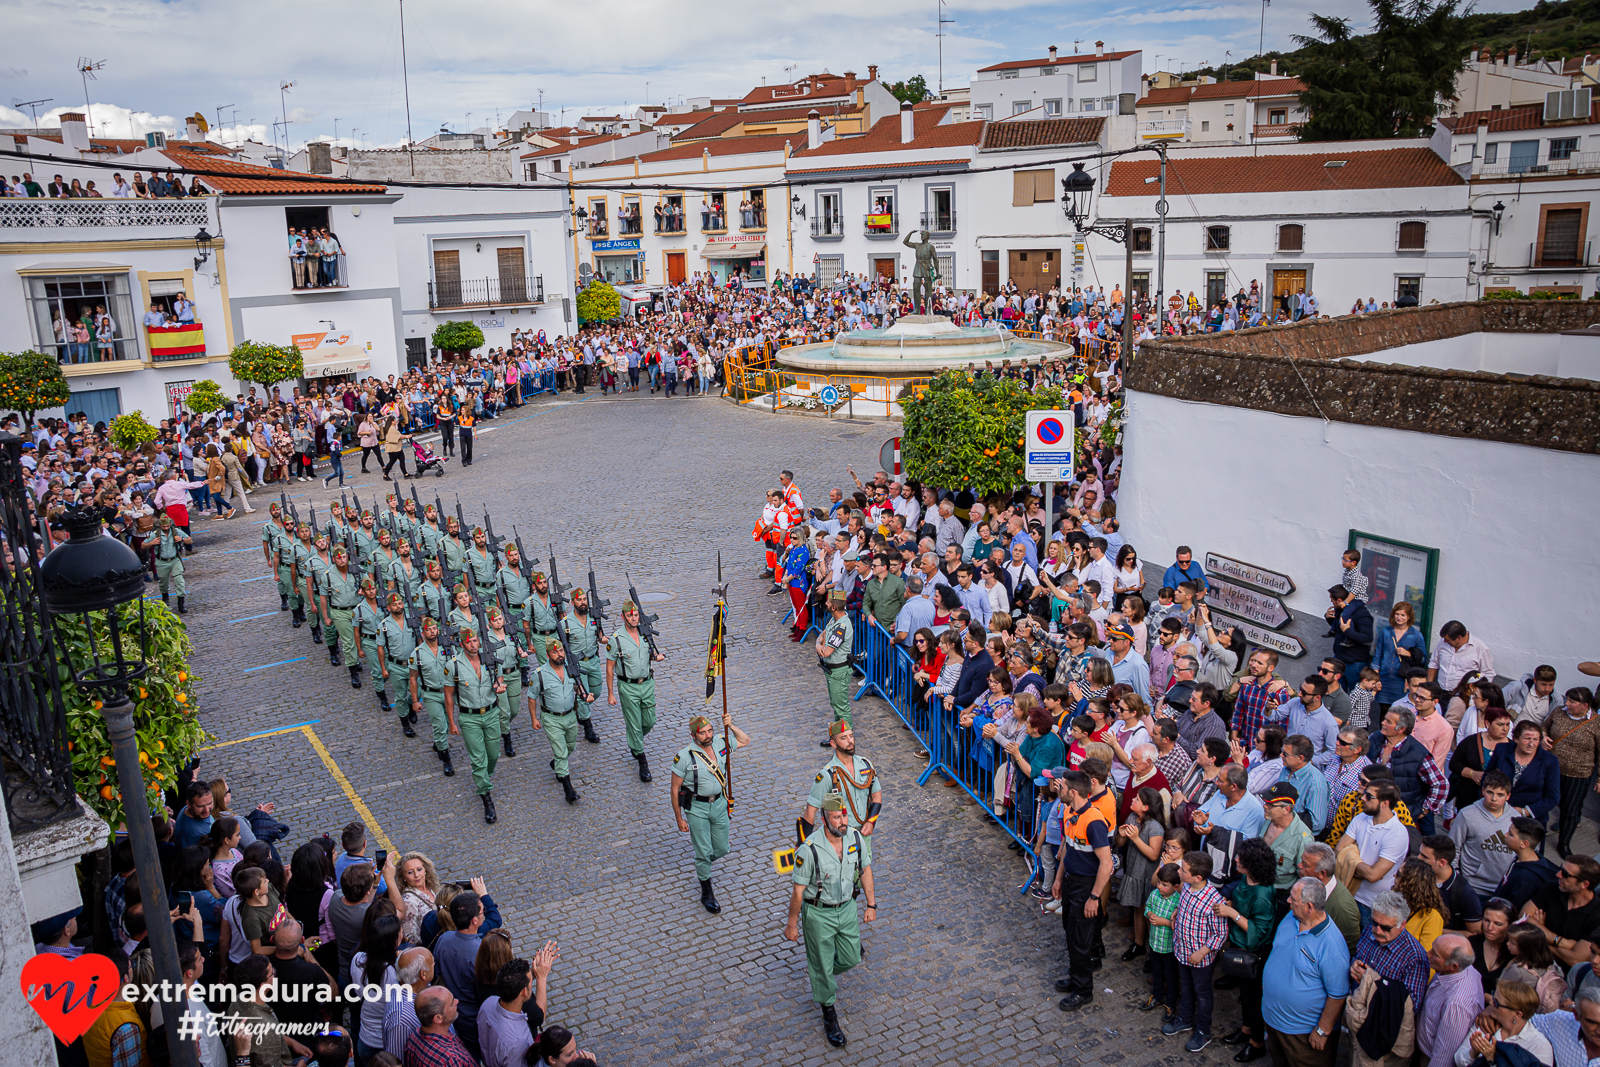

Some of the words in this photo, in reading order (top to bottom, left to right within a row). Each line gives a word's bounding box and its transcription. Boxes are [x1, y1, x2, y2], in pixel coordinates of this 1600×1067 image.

[322, 367, 353, 376] Oriente
[169, 386, 193, 395] VENDE
[1222, 562, 1251, 579] Centro
[1255, 573, 1286, 591] Ciudad
[1227, 587, 1258, 605] Iglesia
[1262, 599, 1274, 610] de
[1223, 598, 1240, 611] San
[1244, 605, 1275, 624] Miguel
[828, 634, 843, 648] PM
[1248, 628, 1259, 640] de
[1262, 633, 1297, 652] Burgos
[1480, 842, 1514, 855] adidas
